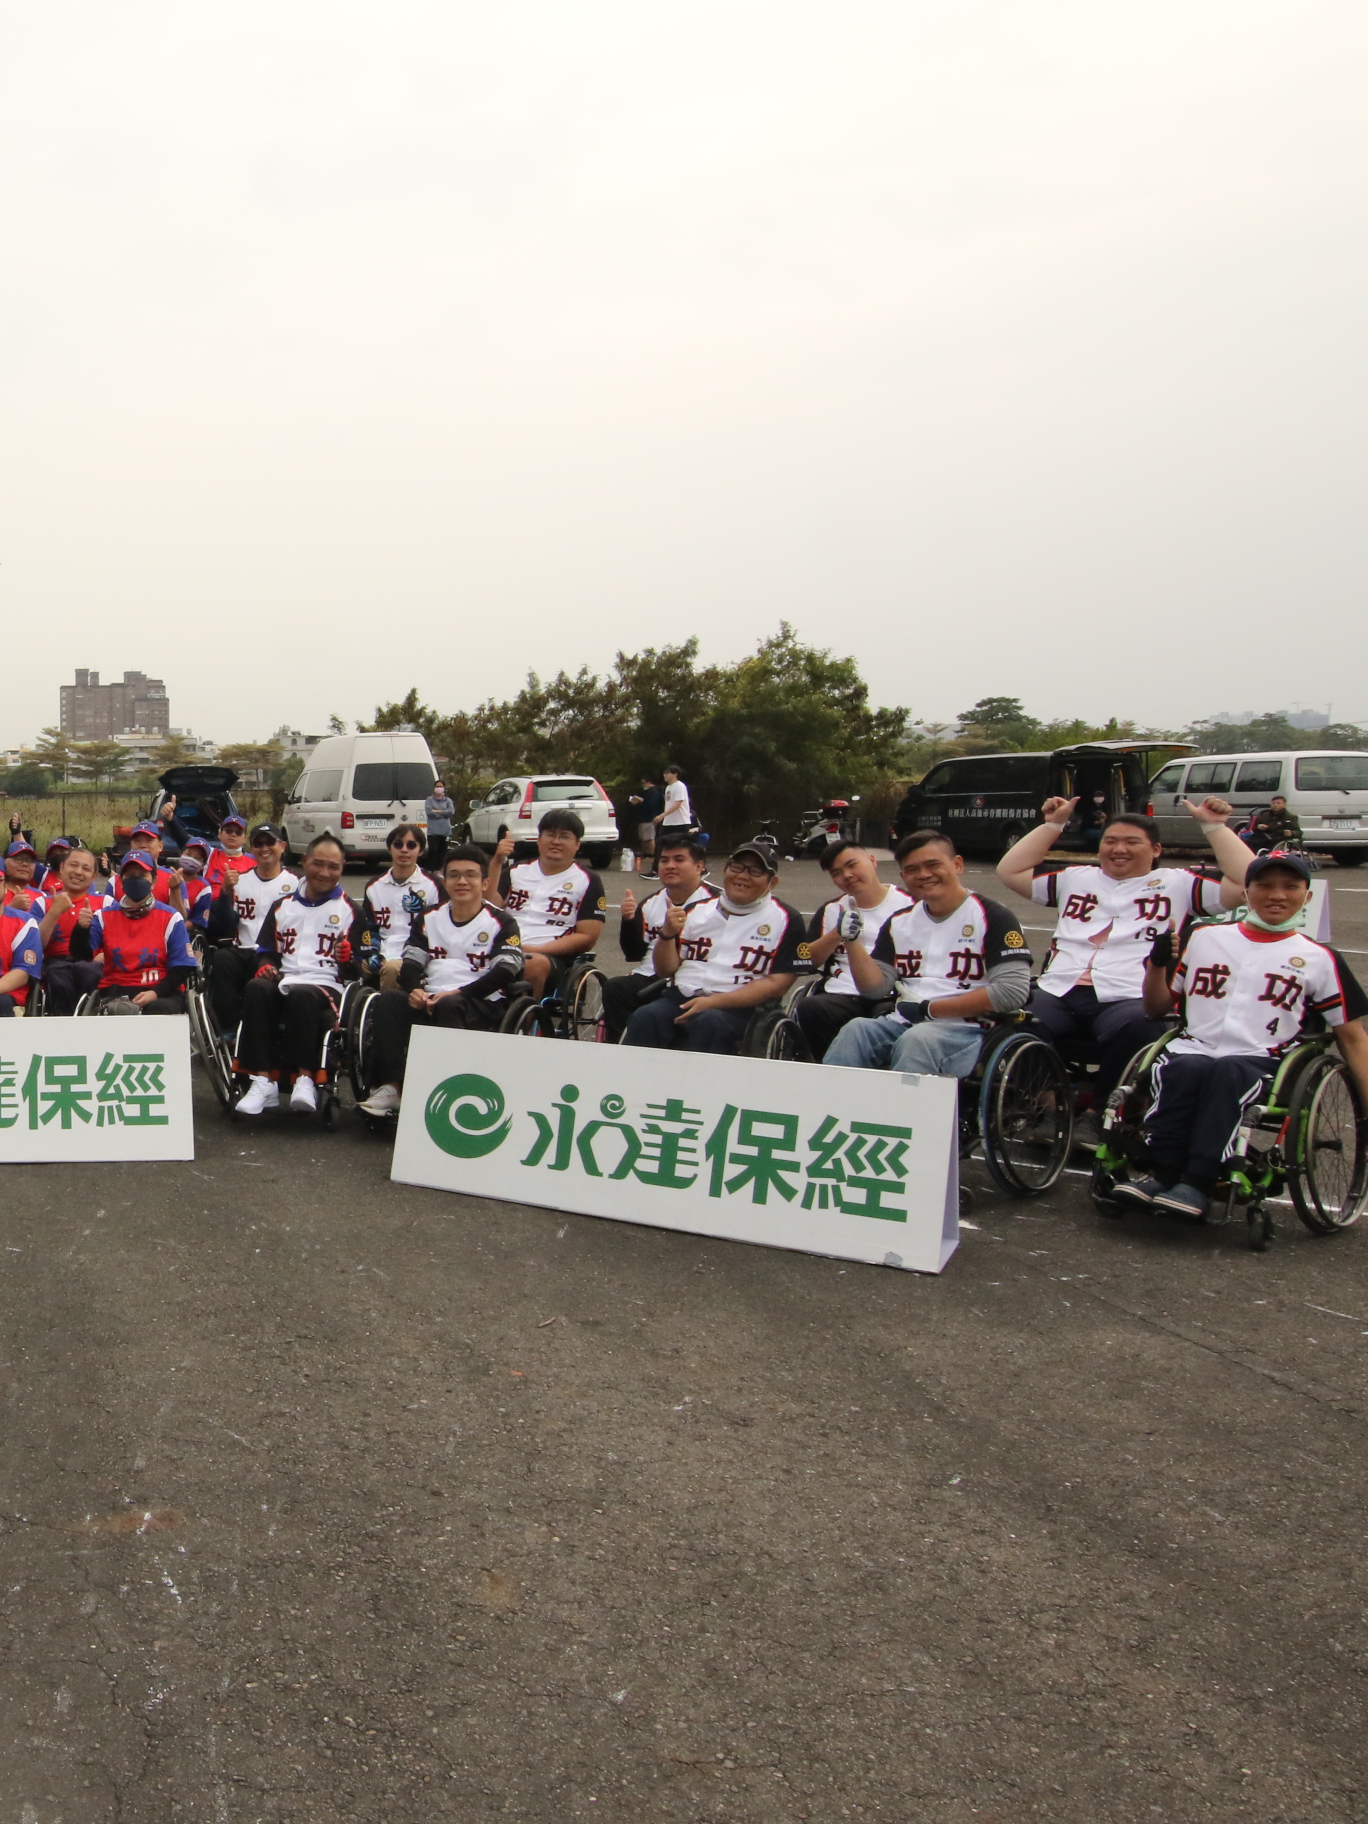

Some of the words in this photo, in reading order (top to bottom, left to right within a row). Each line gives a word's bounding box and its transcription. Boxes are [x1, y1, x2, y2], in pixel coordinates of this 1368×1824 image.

[1062, 893, 1172, 922] 成功
[1188, 963, 1303, 1012] 成功
[1266, 1017, 1280, 1036] 4
[520, 1083, 913, 1223] 永達保經
